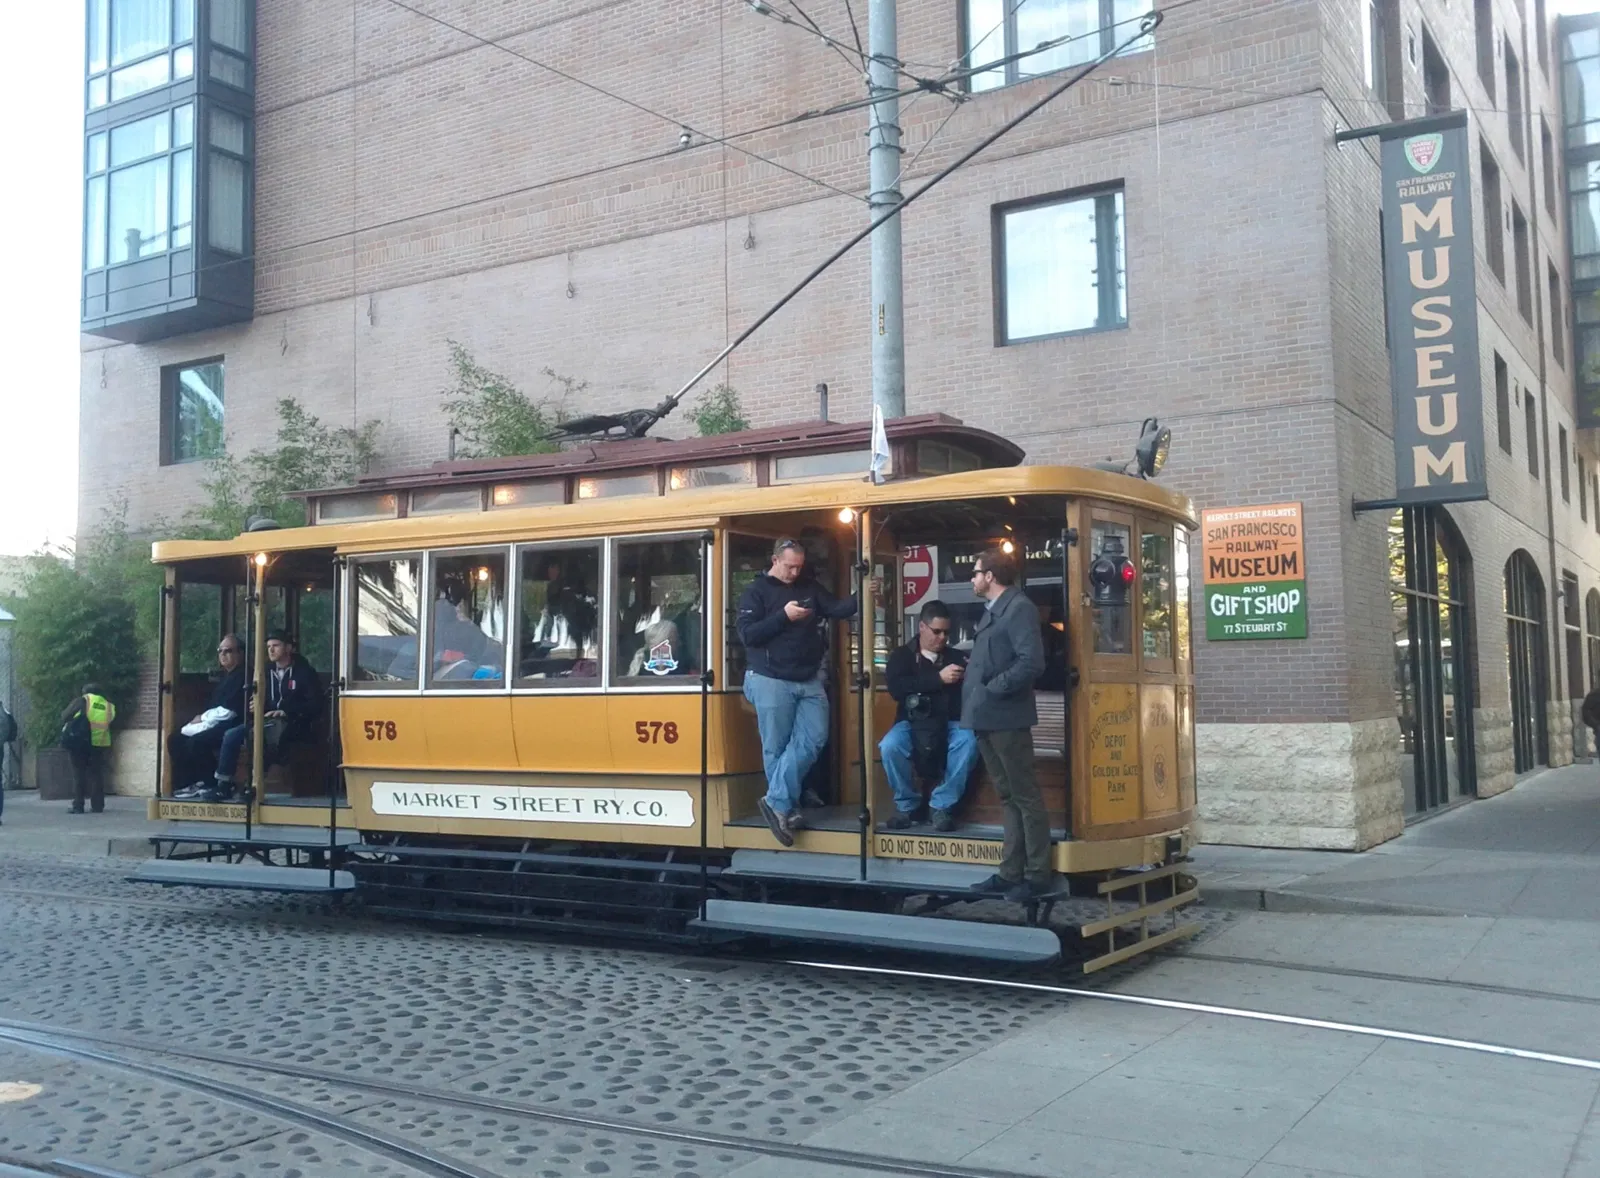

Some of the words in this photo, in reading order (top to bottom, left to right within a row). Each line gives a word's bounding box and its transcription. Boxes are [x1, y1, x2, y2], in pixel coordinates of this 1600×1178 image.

[1399, 180, 1452, 198] RAILWAY
[1400, 196, 1467, 488] MUSEUM
[1208, 526, 1229, 543] SAN
[1231, 522, 1297, 538] FRANCISCO
[1226, 539, 1279, 553] RAILWAY
[1209, 551, 1298, 579] MUSEUM
[1243, 585, 1267, 594] AND
[1210, 593, 1252, 616] GIFT
[1254, 589, 1300, 615] SHOP
[1235, 622, 1276, 634] STEUART
[1276, 621, 1288, 632] ST
[364, 720, 397, 741] 578
[635, 721, 679, 744] 578
[1104, 734, 1126, 748] DEPOT
[1092, 764, 1120, 778] GOLDEN
[1107, 780, 1126, 793] PARK
[392, 792, 481, 809] MARKET
[493, 796, 585, 813] STREET
[593, 799, 630, 815] RY.
[633, 800, 668, 817] CO.
[880, 838, 894, 853] DO
[897, 839, 914, 855] NOT
[918, 840, 947, 857] STAND
[951, 843, 964, 858] ON
